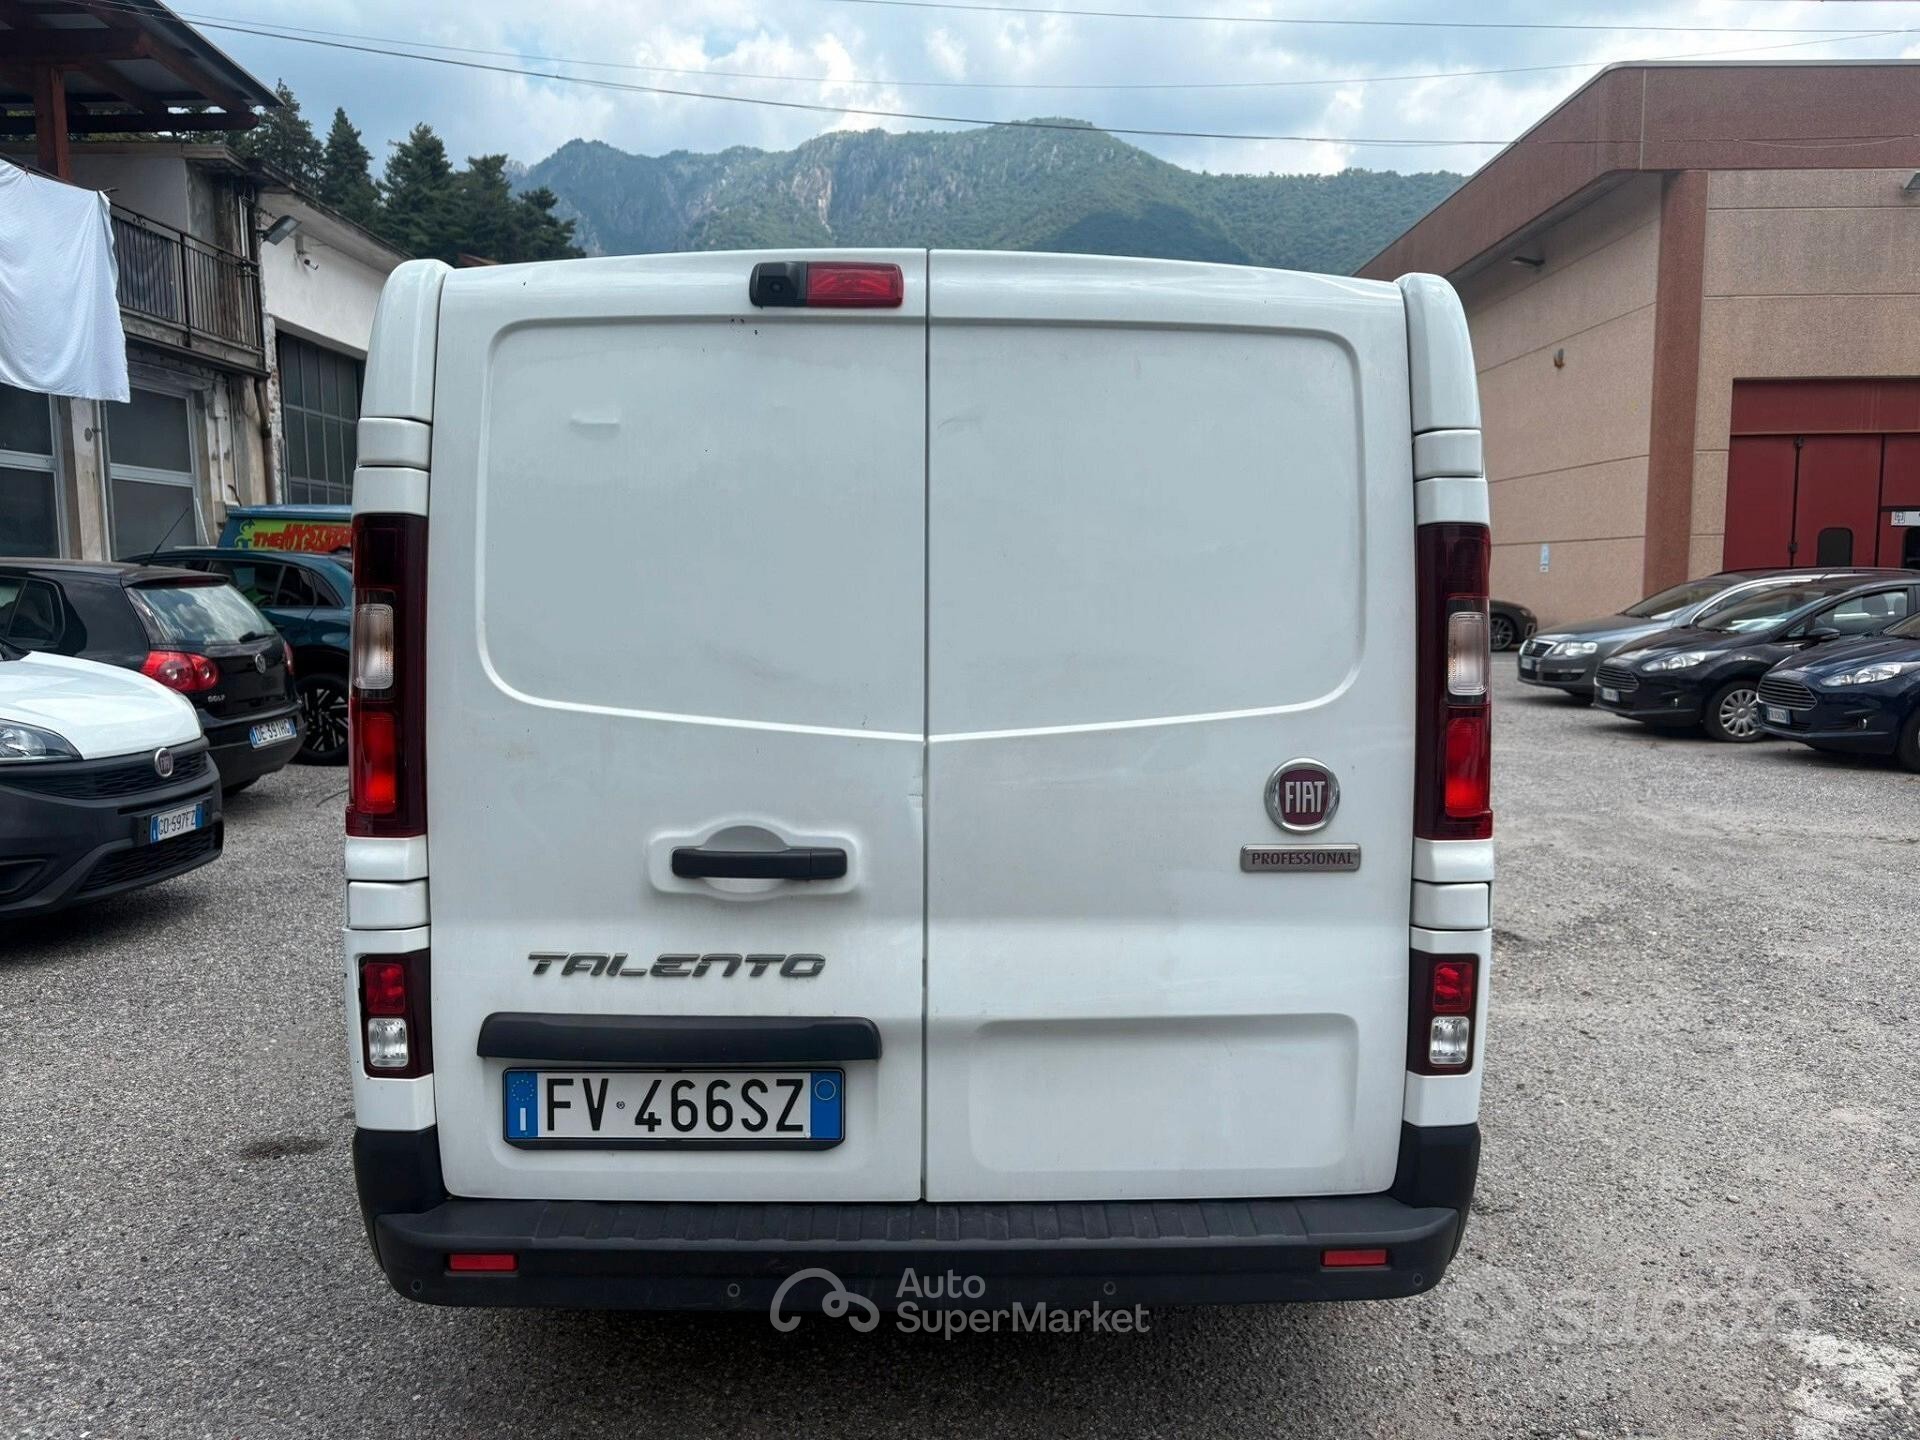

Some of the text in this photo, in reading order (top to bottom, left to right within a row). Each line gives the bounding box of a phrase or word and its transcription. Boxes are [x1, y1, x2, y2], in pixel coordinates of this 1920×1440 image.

[1284, 781, 1326, 814] FIAT
[1251, 852, 1354, 866] PROFESSIONAL
[528, 951, 827, 978] TALENTO
[546, 1078, 609, 1132] FV
[634, 1078, 804, 1133] 466SZ
